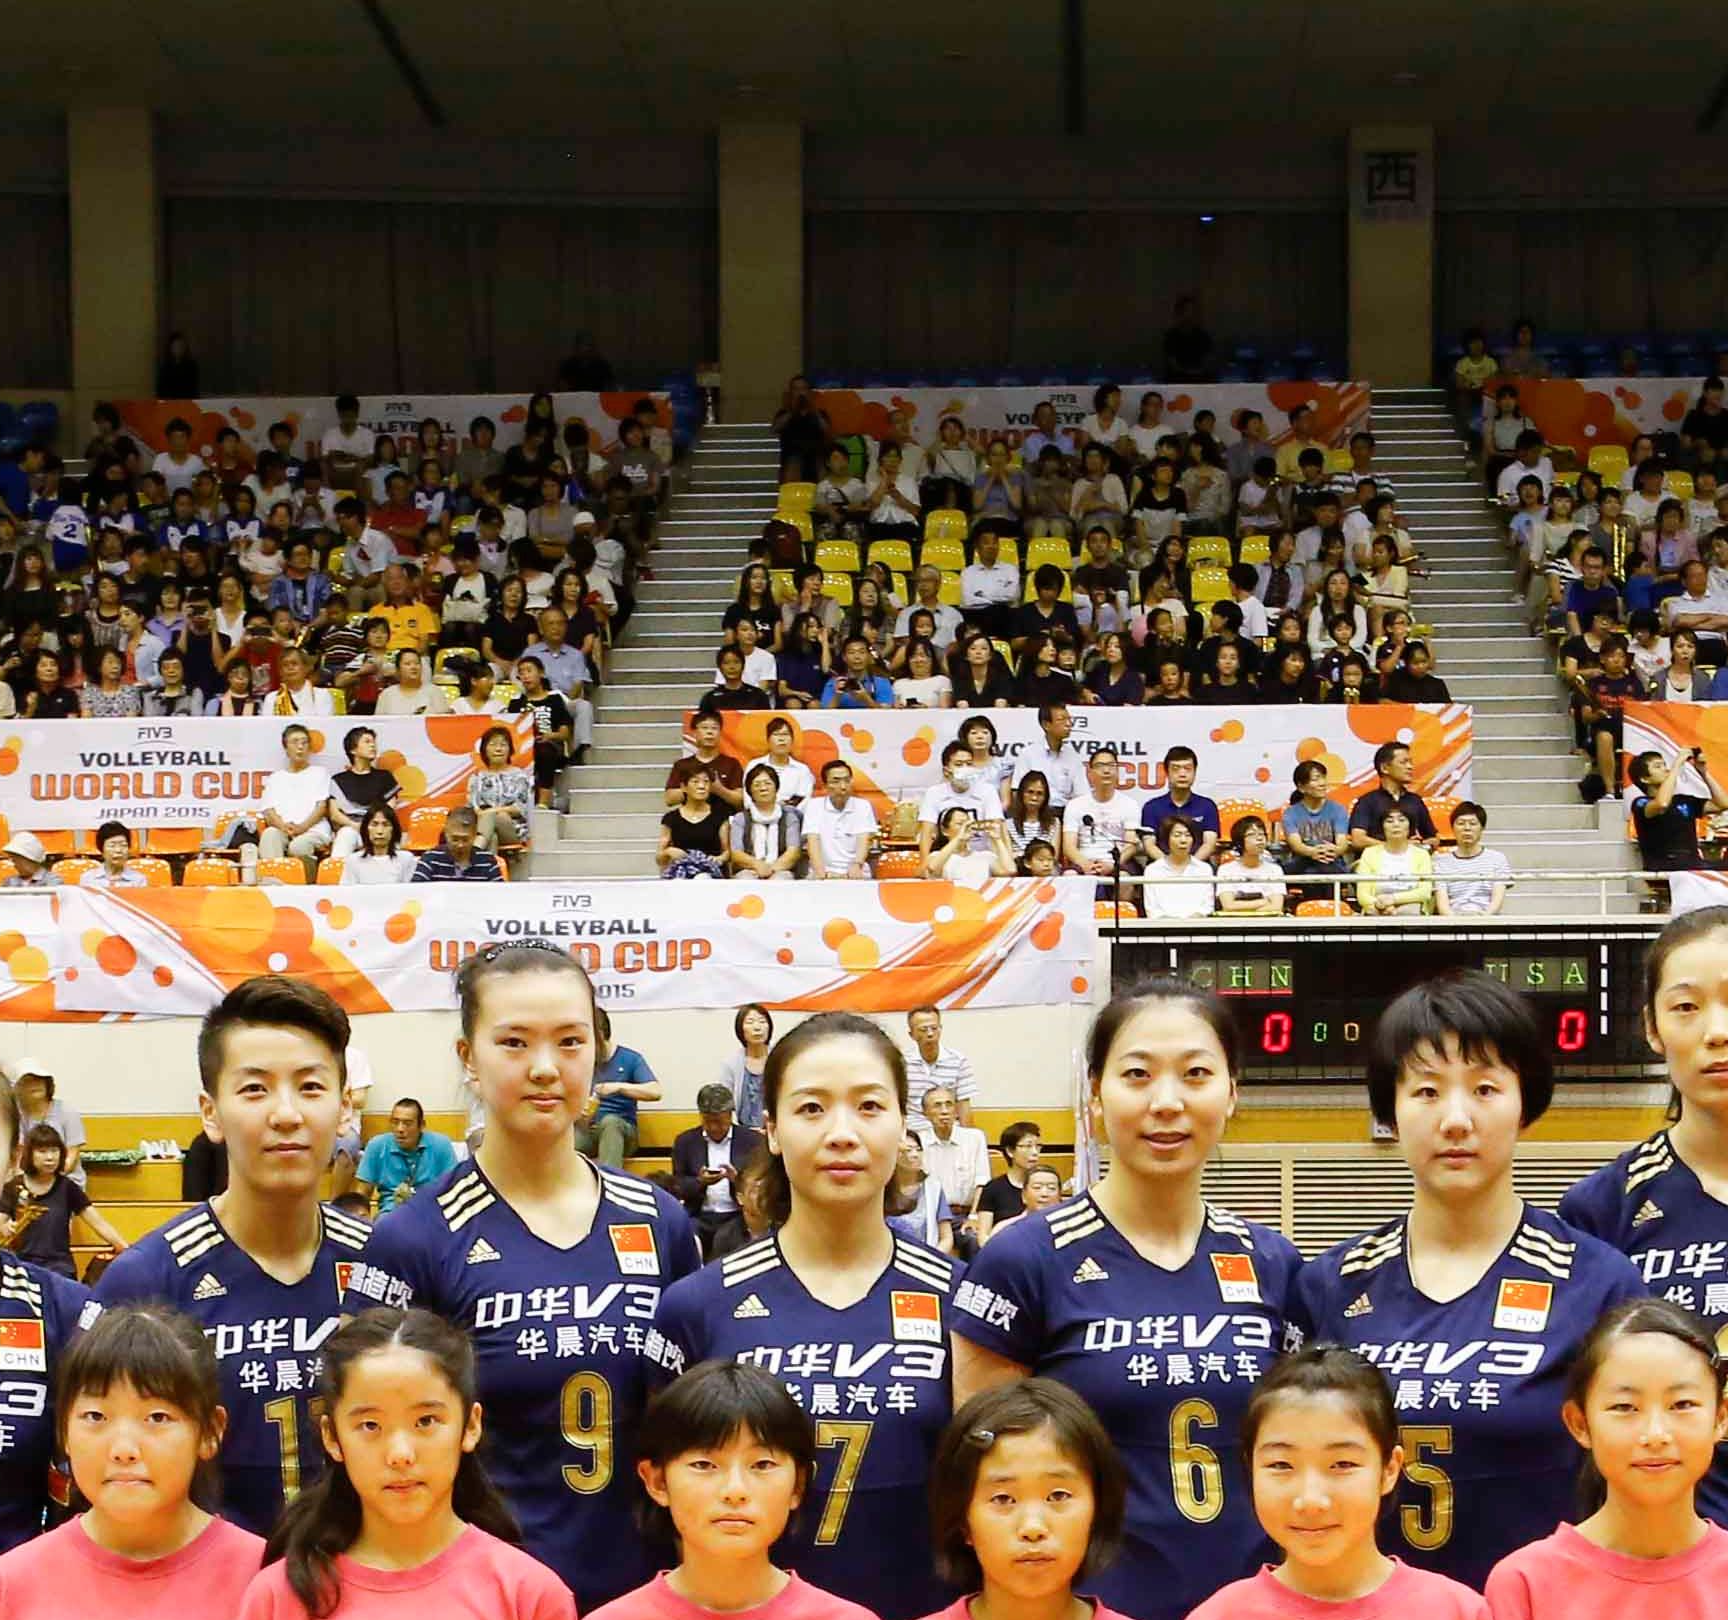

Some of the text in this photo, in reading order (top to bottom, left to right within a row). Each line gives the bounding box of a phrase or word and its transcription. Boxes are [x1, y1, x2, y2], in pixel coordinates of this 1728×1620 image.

[1368, 152, 1416, 203] 西
[137, 727, 173, 739] FIVB
[79, 751, 232, 767] VOLLEYBALL
[30, 771, 182, 801] WORLD
[96, 806, 210, 819] JAPAN 2015
[552, 894, 592, 908] FIVB
[486, 918, 658, 936] VOLLEYBALL
[613, 938, 712, 974] CUP
[1190, 965, 1292, 991] CHN
[1263, 1012, 1291, 1054] 0
[1313, 1022, 1327, 1042] 0
[1558, 1010, 1585, 1052] 0
[622, 1257, 656, 1271] CHN
[474, 1281, 662, 1328] 中华V3
[1225, 1285, 1257, 1300] CHN
[901, 1323, 938, 1337] CHN
[1502, 1310, 1541, 1326] CHN
[515, 1321, 645, 1361] 华晨汽车
[1083, 1315, 1272, 1354] 中华V3
[3, 1352, 40, 1367] CHN
[1126, 1351, 1262, 1387] 华晨汽车
[559, 1369, 614, 1496] 9
[1169, 1398, 1225, 1524] 6
[813, 1419, 874, 1546] 7
[1400, 1425, 1454, 1551] 5
